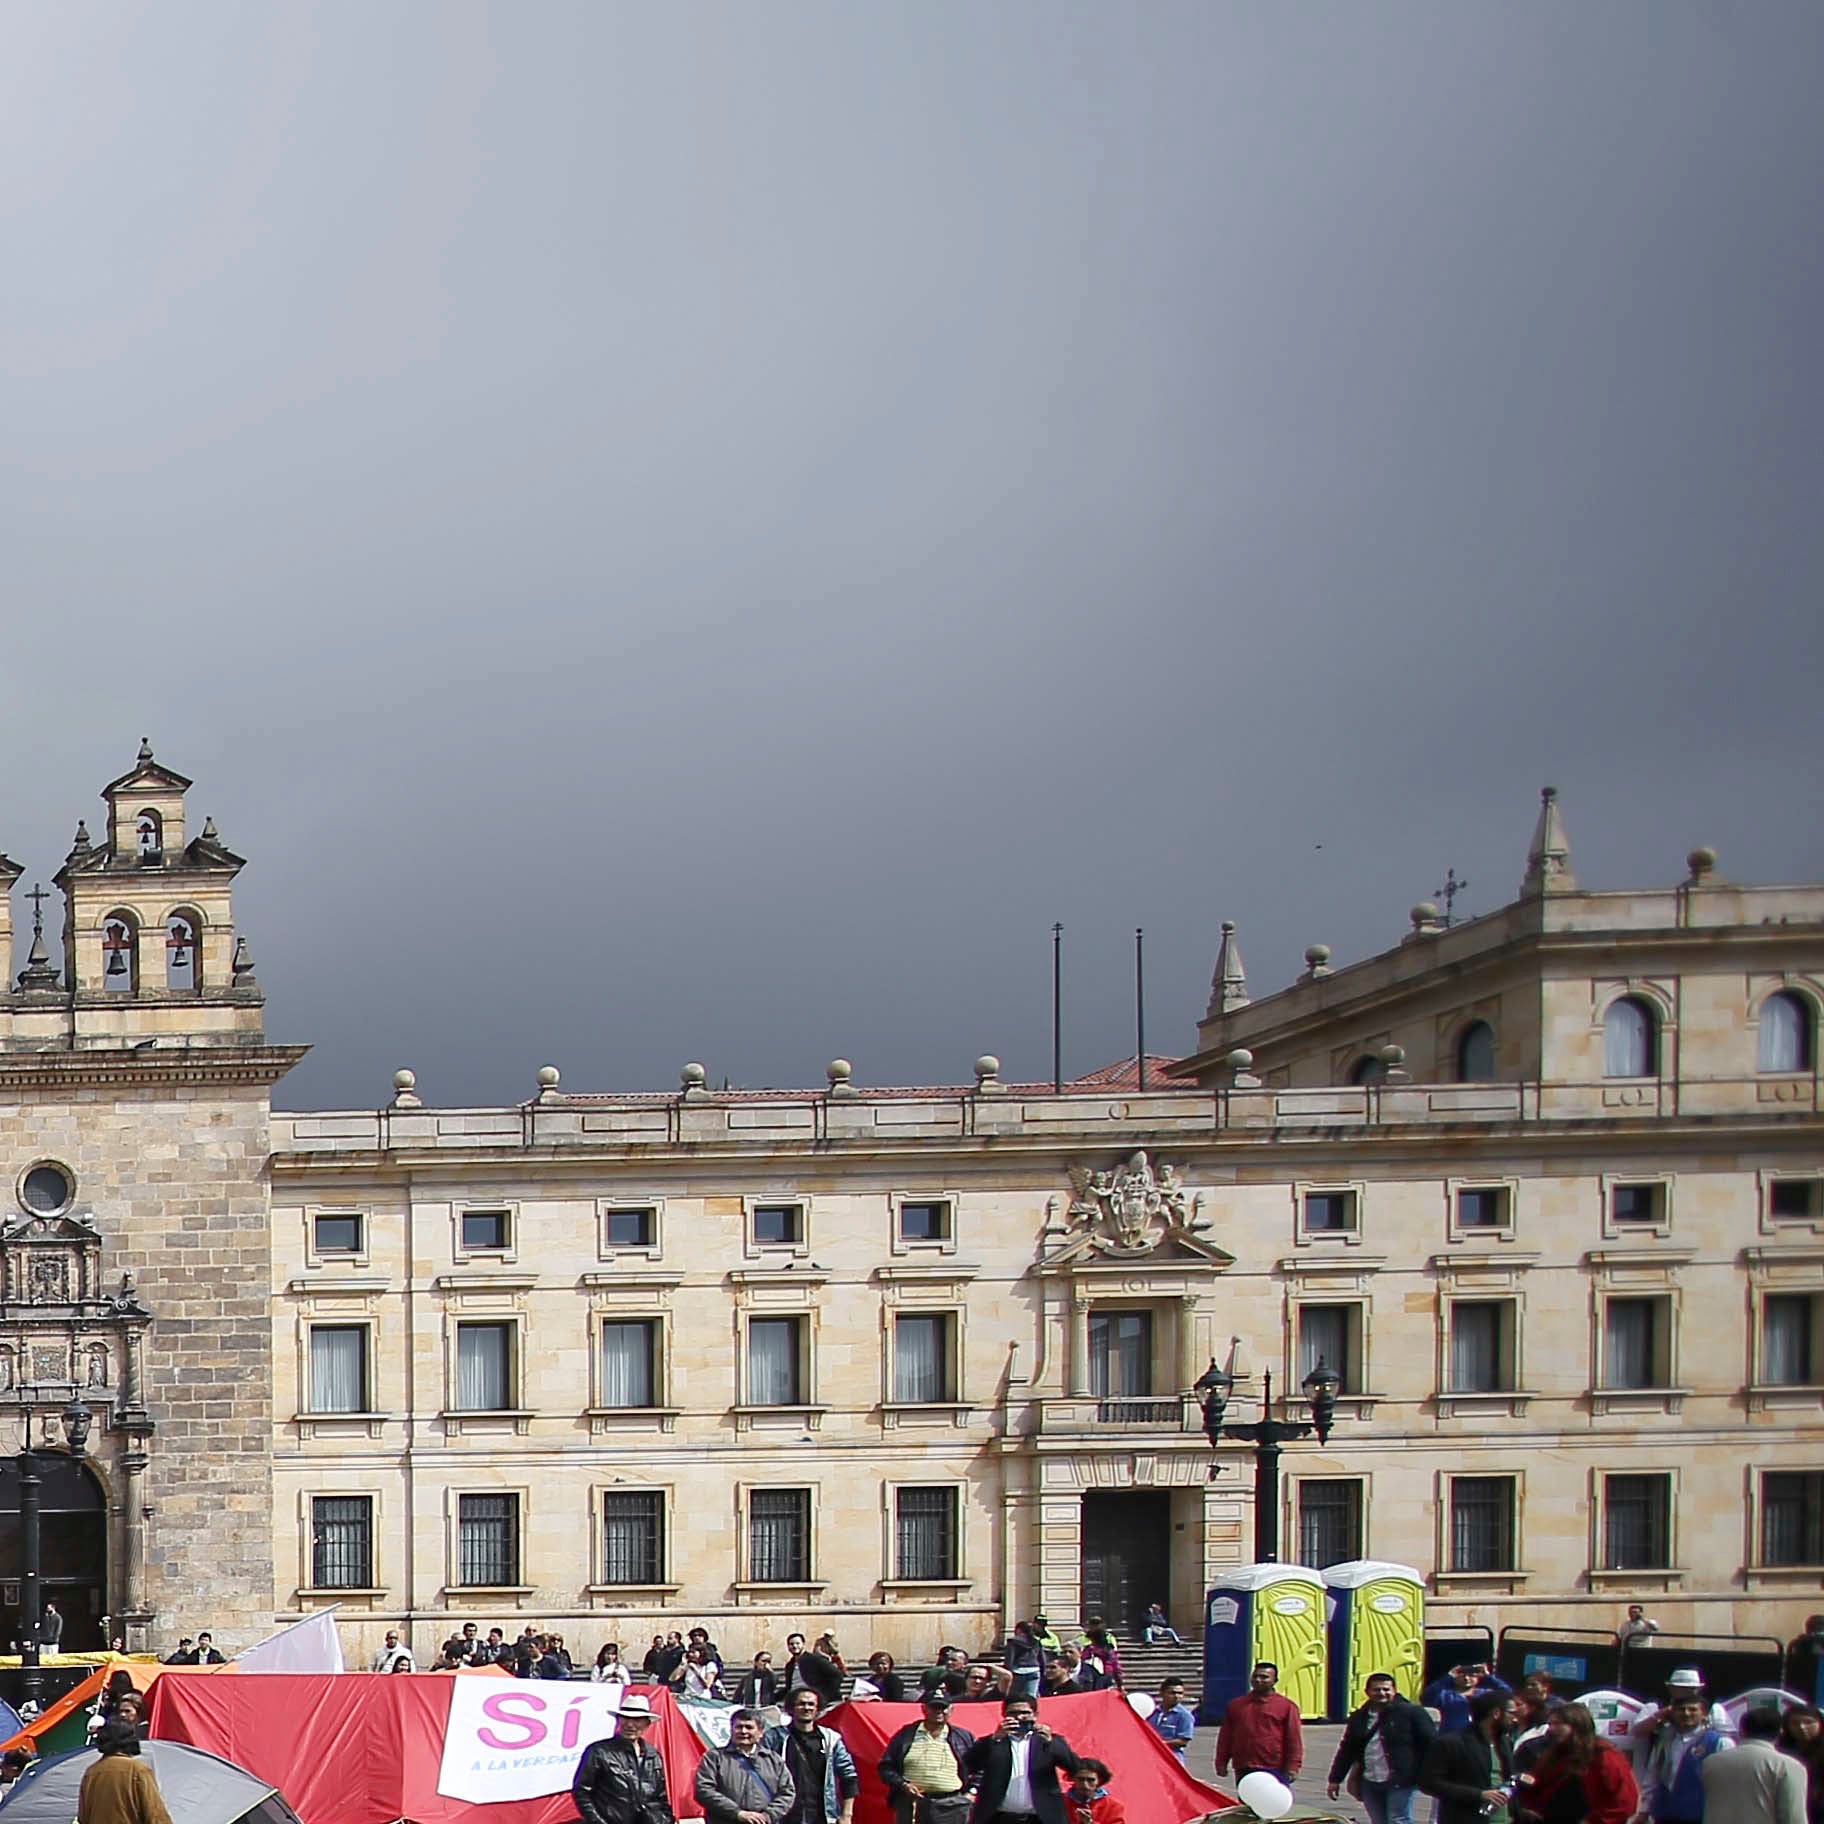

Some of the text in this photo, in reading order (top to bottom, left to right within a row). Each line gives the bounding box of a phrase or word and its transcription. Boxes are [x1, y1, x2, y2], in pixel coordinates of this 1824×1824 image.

[477, 1692, 590, 1750] Sí
[471, 1759, 481, 1771] A
[488, 1758, 507, 1770] LA
